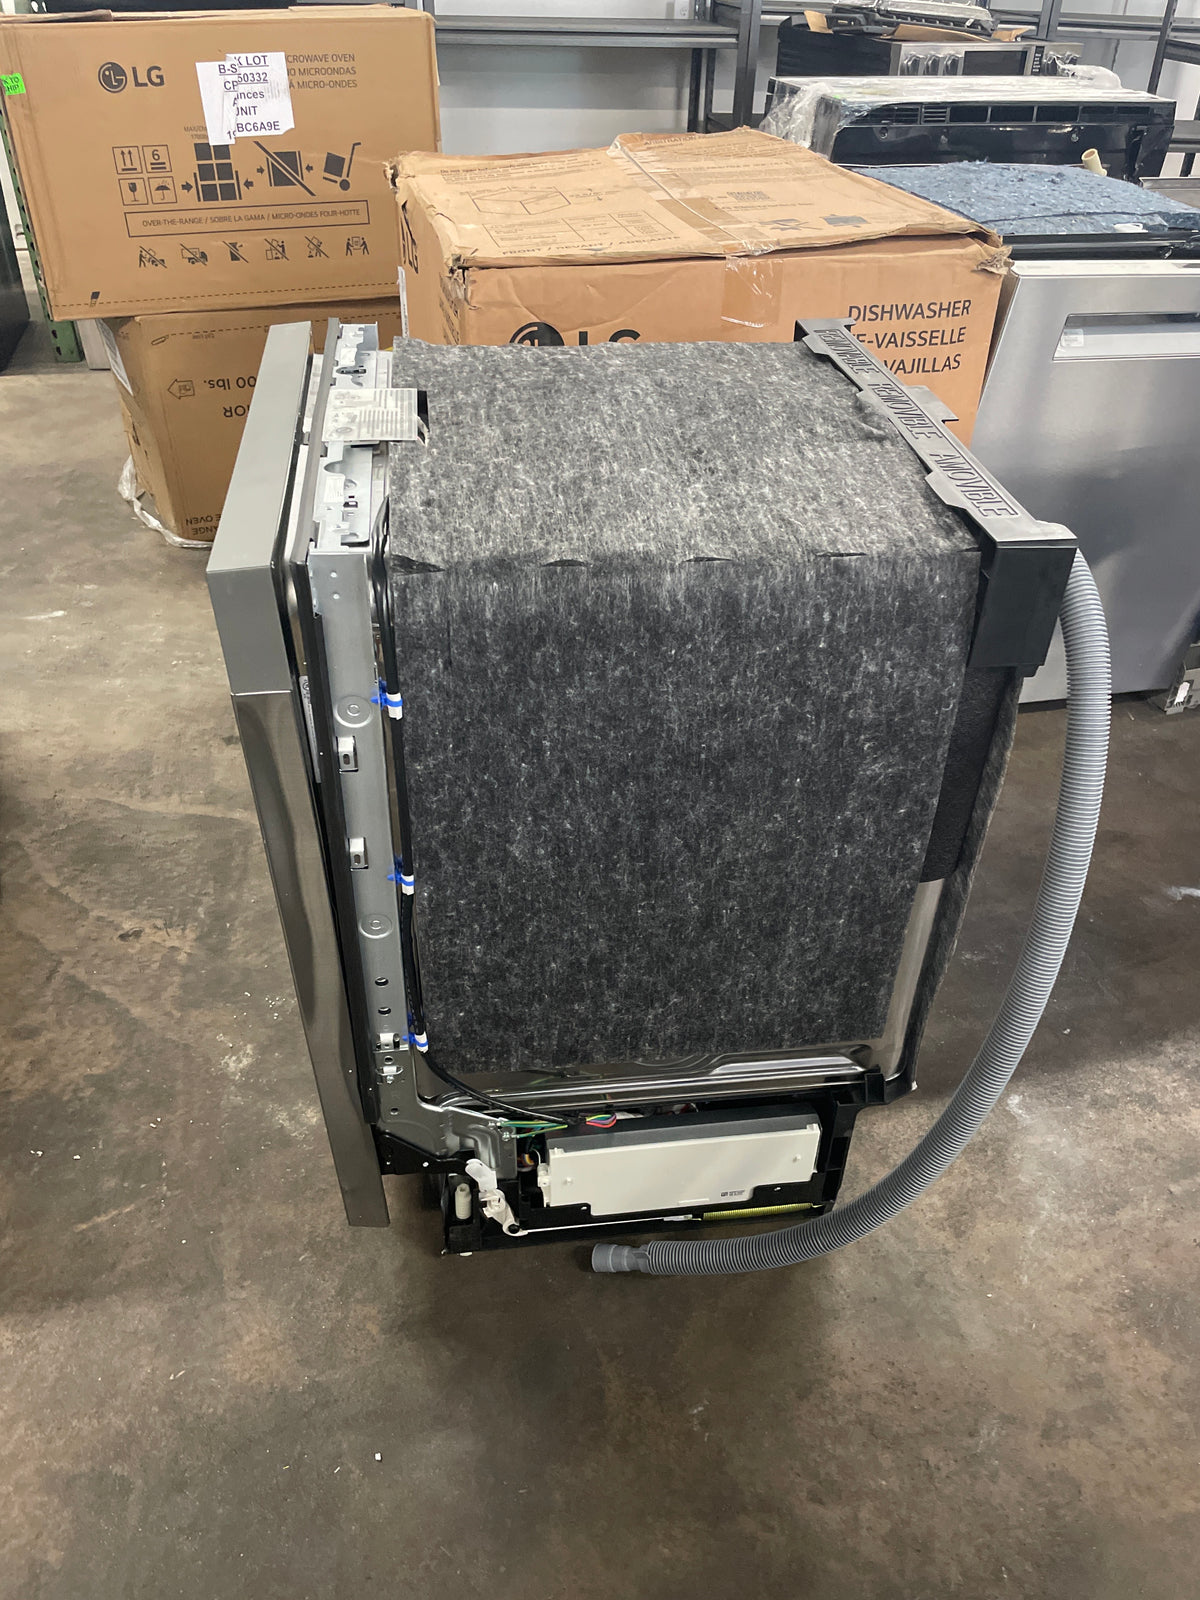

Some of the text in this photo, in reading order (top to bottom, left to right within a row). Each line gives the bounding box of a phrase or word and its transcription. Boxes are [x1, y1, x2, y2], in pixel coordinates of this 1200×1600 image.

[245, 55, 268, 66] LOT
[285, 54, 355, 63] CROWAVE OVEN
[131, 65, 165, 87] LG
[298, 66, 357, 77] MICROONDAS
[297, 79, 358, 90] MICRO-ONDES
[237, 120, 281, 133] BC6A9E
[151, 149, 161, 161] 6
[142, 216, 204, 228] OVER-THE-RANGE
[233, 215, 243, 223] LA
[244, 212, 265, 222] GAMA
[272, 210, 319, 220] MICRO-ONDES
[848, 299, 972, 322] DISHWASHER
[203, 376, 231, 390] lbs.
[929, 452, 1019, 518] AMOVIBLE
[185, 515, 214, 526] OVEN
